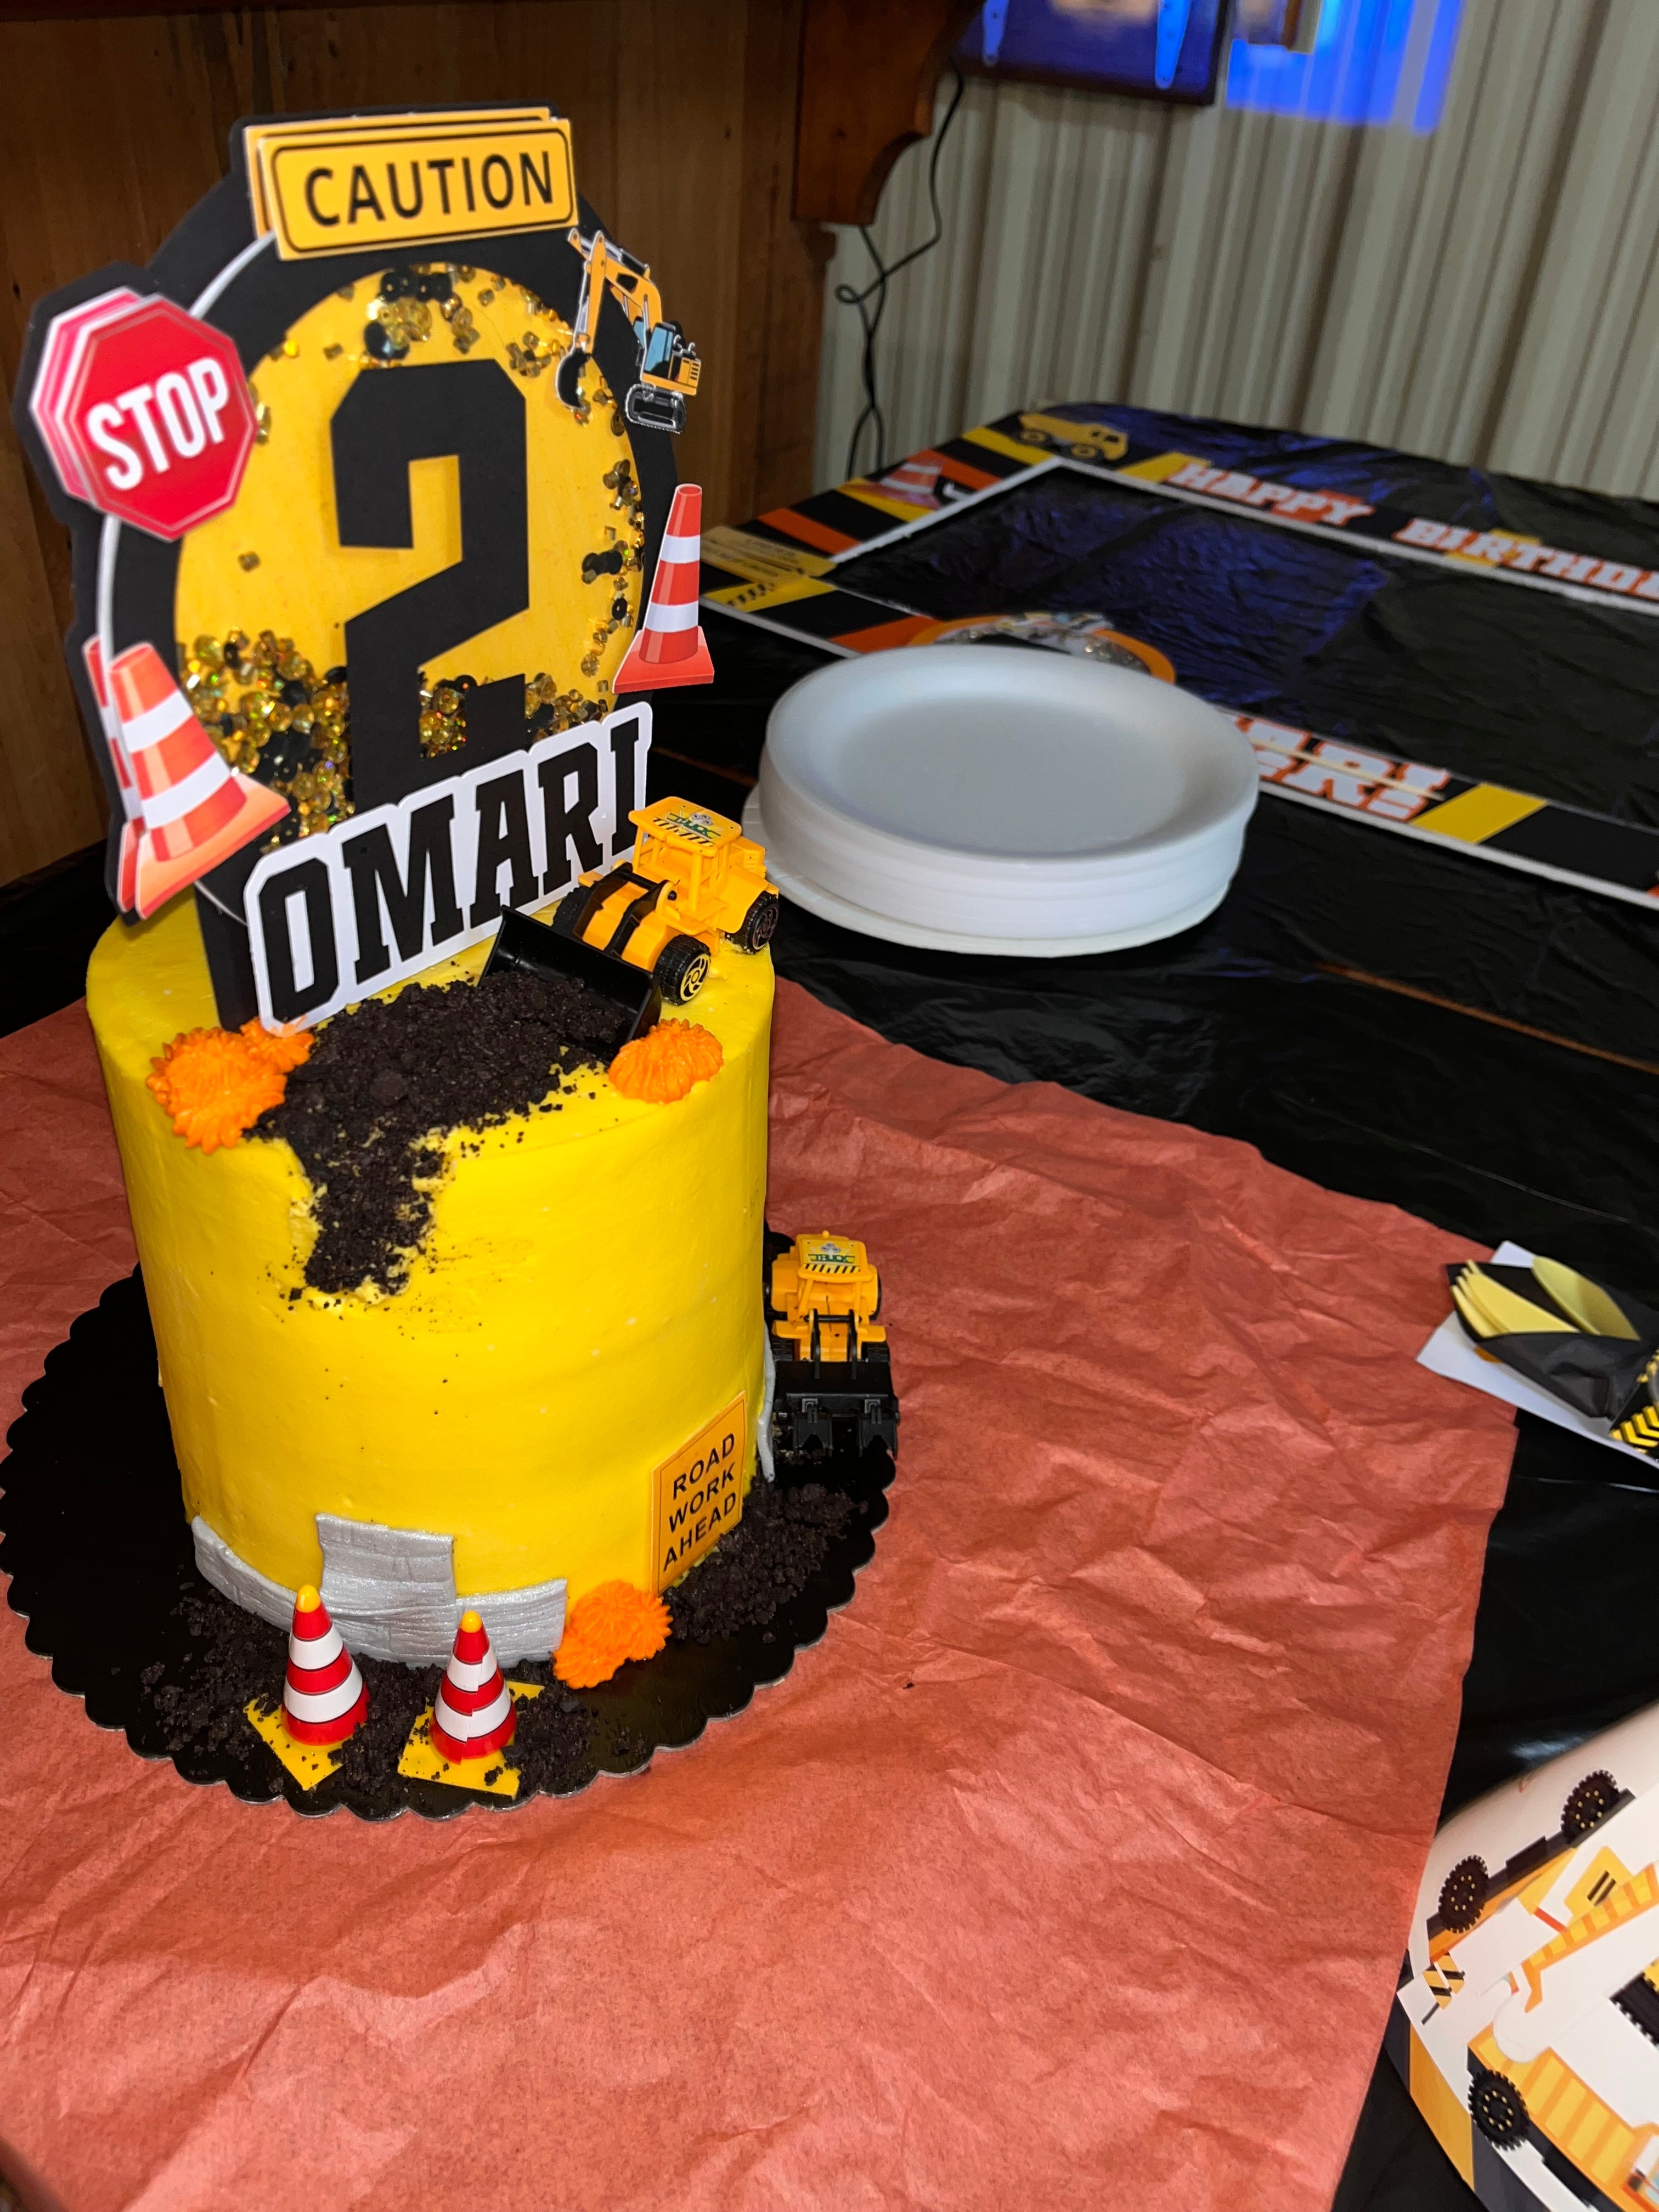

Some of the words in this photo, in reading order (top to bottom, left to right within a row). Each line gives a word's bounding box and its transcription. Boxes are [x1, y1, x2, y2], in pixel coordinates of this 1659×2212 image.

[304, 151, 552, 227] CAUTION
[86, 357, 229, 490] STOP
[1165, 462, 1375, 527] HAPPY
[330, 359, 529, 812] 2
[258, 718, 640, 1023] OMARI
[668, 1462, 736, 1533] WORK
[673, 1433, 735, 1500] ROAD
[663, 1492, 736, 1573] AHEAD
